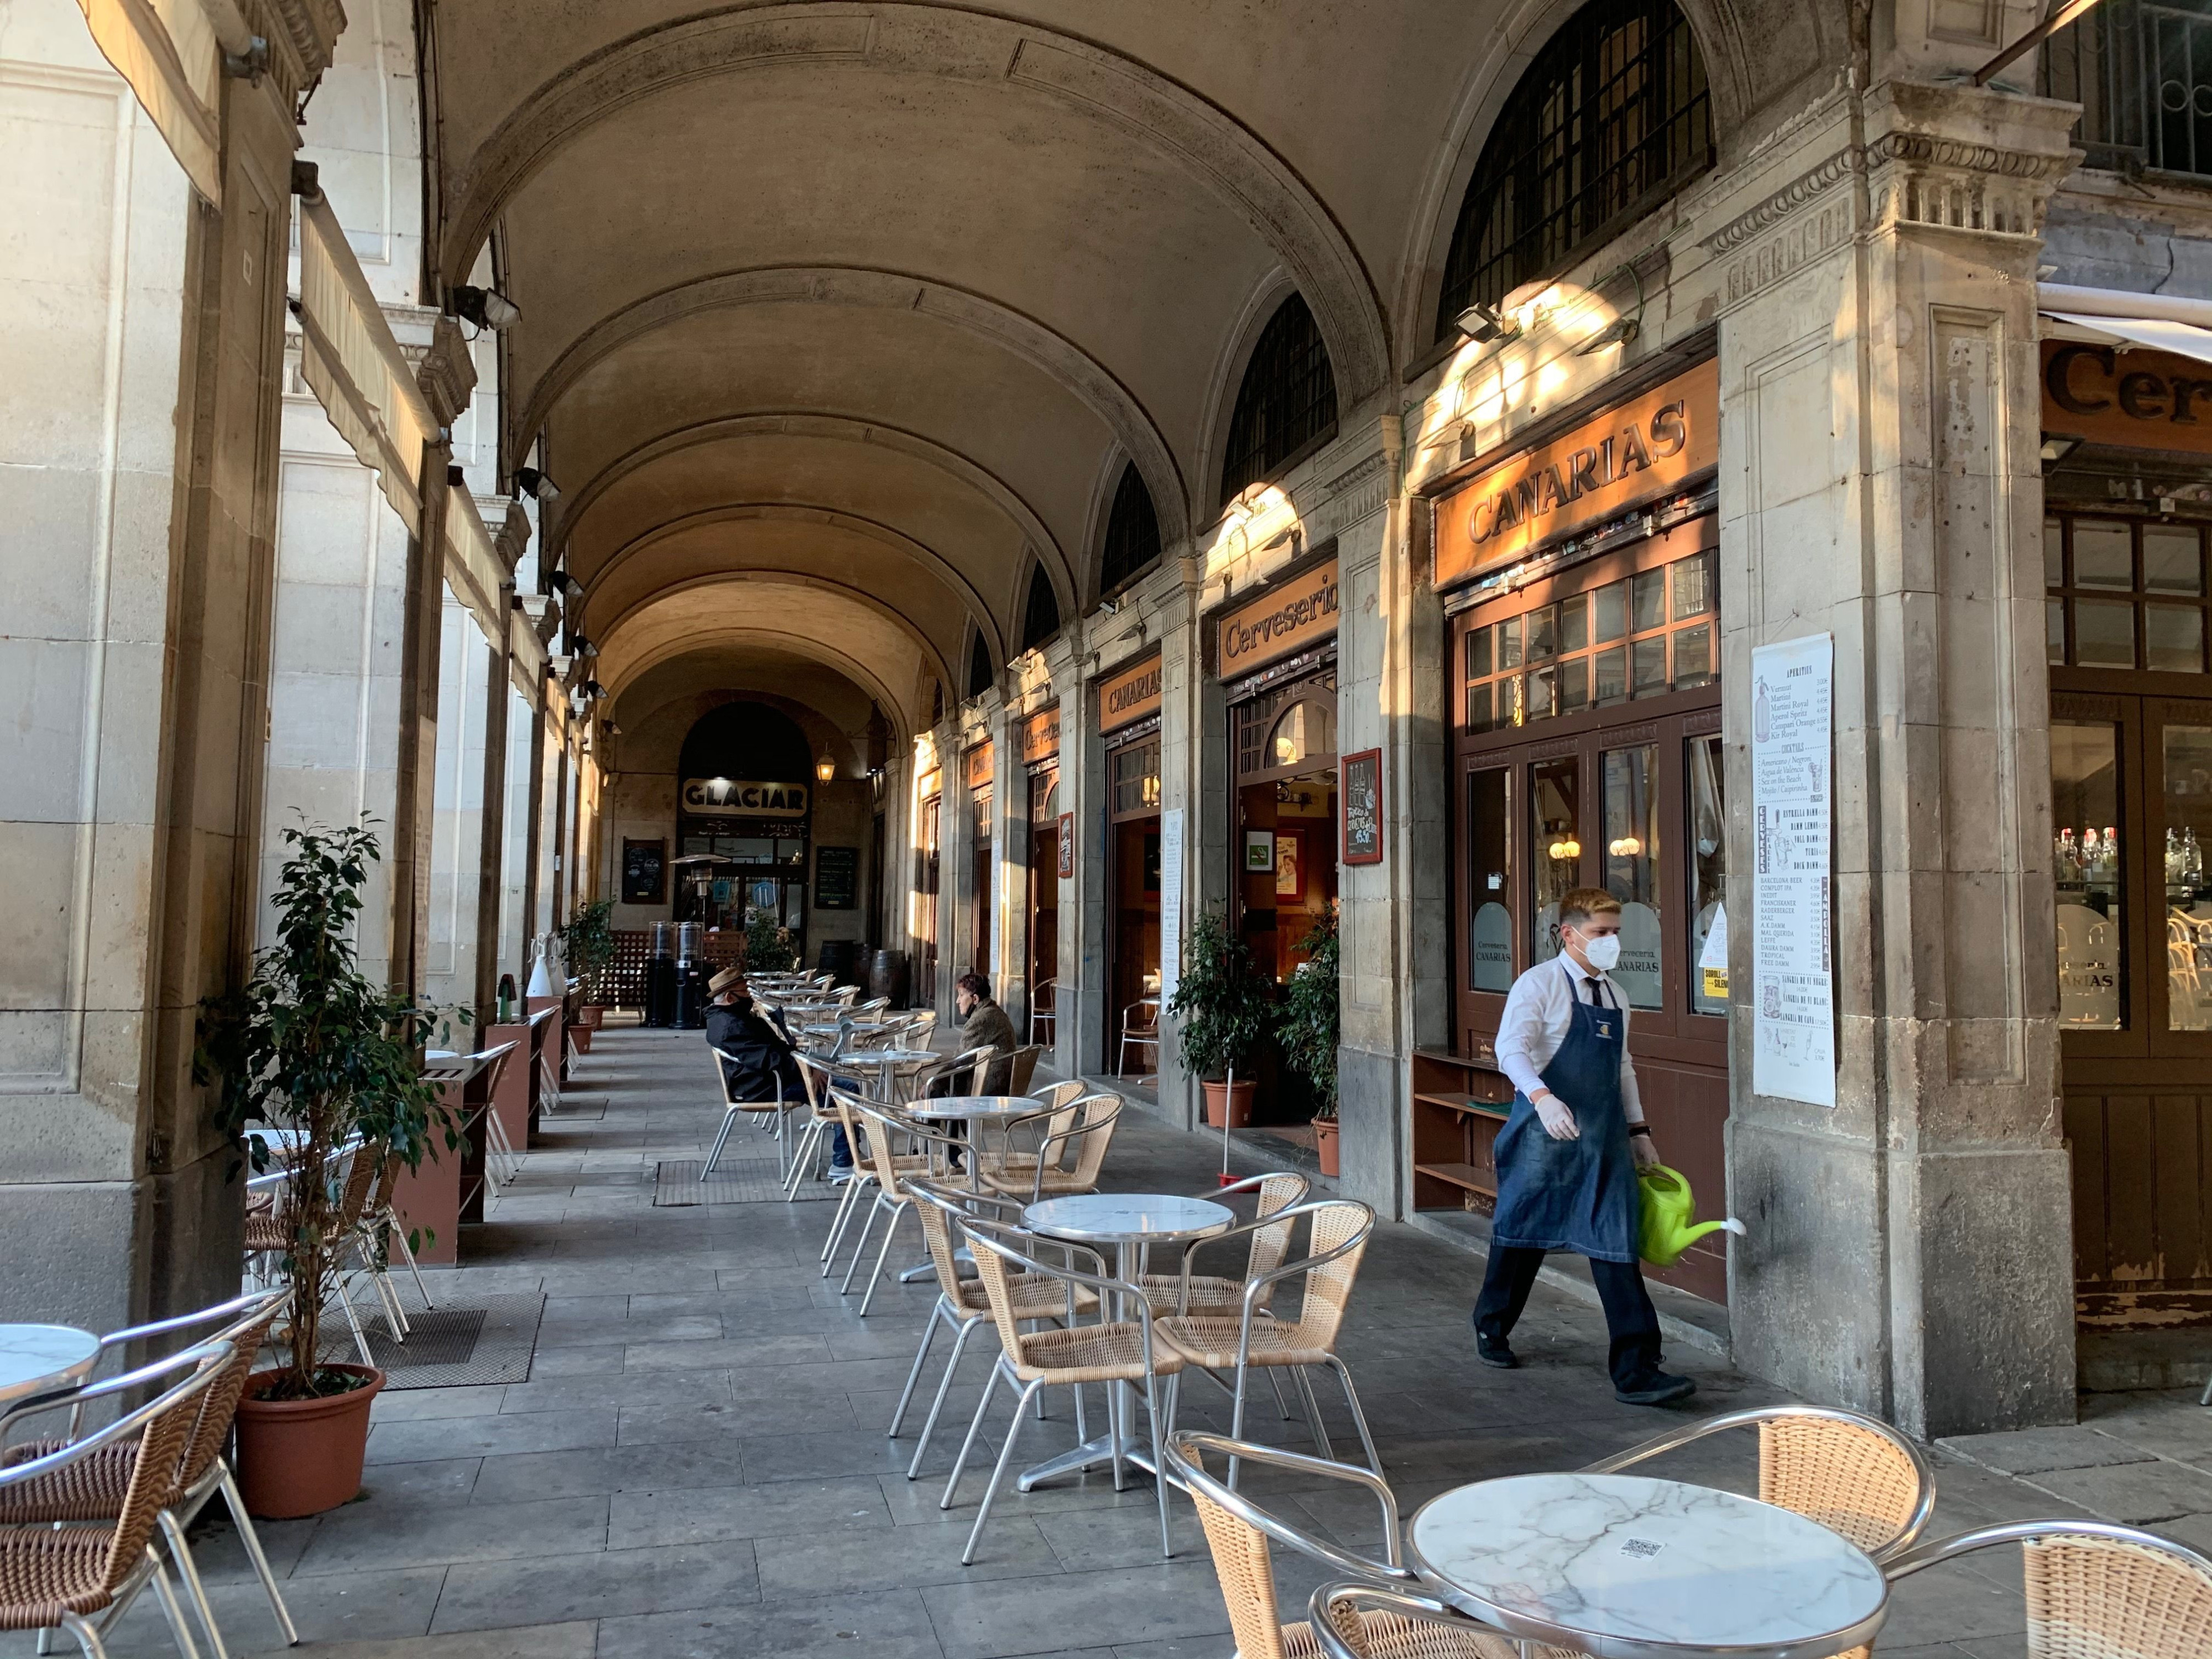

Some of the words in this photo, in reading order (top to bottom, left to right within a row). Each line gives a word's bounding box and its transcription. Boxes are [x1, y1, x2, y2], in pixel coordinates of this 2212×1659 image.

[1468, 399, 1686, 545] CANARIAS
[1771, 693, 1791, 702] Martini
[1771, 702, 1791, 712] Martini
[1792, 700, 1808, 711] Royal
[1771, 712, 1789, 721] Aperol
[1790, 709, 1807, 719] Spritz
[1771, 721, 1794, 730] Campari
[1796, 718, 1815, 727] Orange
[1771, 731, 1780, 739] Kir
[1781, 729, 1797, 739] Royal
[1782, 743, 1804, 754] COCKTAILS
[1792, 754, 1812, 765] Negroni
[1787, 774, 1801, 783] Beach
[1781, 783, 1807, 794] Caipirinha
[685, 785, 804, 810] GLACIAR
[1783, 809, 1805, 818] ESTRELLA
[1807, 808, 1818, 816] DAMM
[1804, 821, 1818, 830] LEMON
[1794, 835, 1805, 843] VOLL
[1807, 834, 1818, 843] DAMM
[1476, 952, 1511, 962] CANARIAS
[1705, 969, 1721, 978] SOROLL
[1782, 975, 1798, 984] SANGRIA
[1800, 976, 1805, 984] DE
[1807, 977, 1812, 985] VI
[1813, 977, 1827, 986] NEGRE
[1783, 994, 1799, 1003] SANGRIA
[1801, 995, 1806, 1004] DE
[1808, 996, 1812, 1005] VI
[1814, 997, 1827, 1005] BLANC
[1780, 1013, 1797, 1022] SANGRIA
[1798, 1014, 1802, 1023] DE
[1804, 1015, 1814, 1024] CAVA
